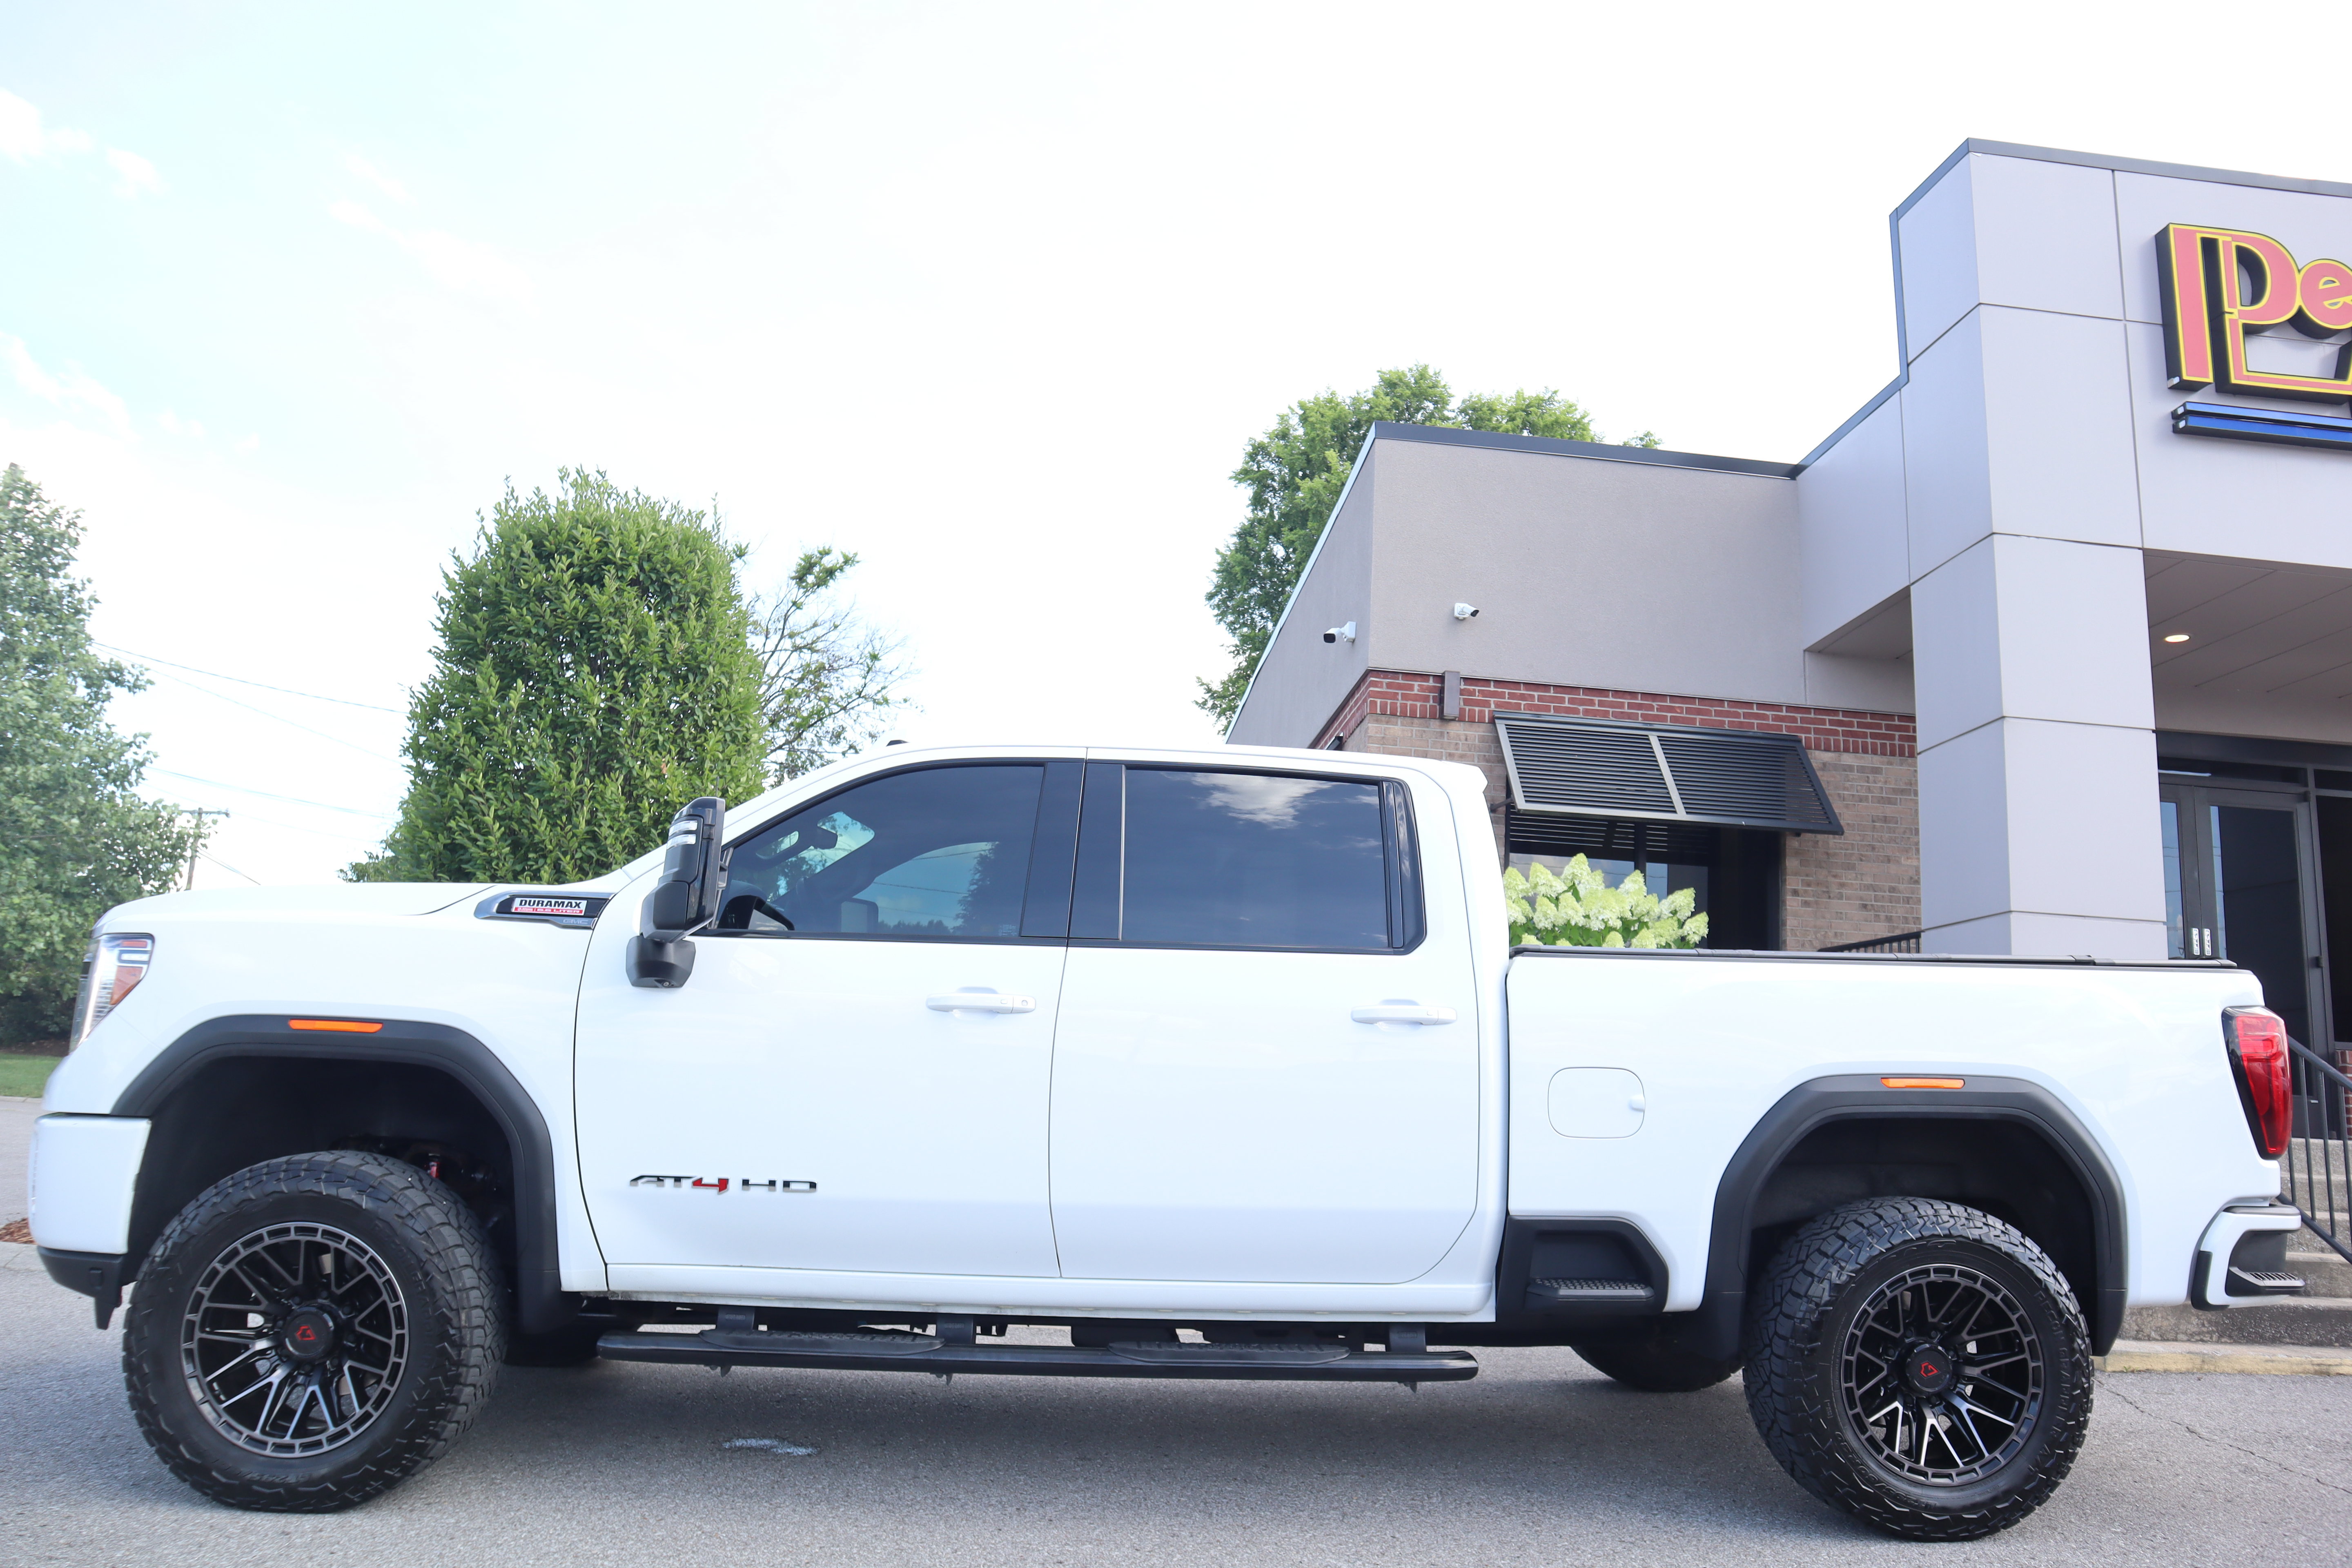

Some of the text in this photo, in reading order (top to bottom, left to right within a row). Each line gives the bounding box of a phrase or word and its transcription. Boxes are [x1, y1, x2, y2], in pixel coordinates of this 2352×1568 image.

[519, 899, 582, 909] DURAMAX
[629, 1174, 818, 1194] AT4 HD
